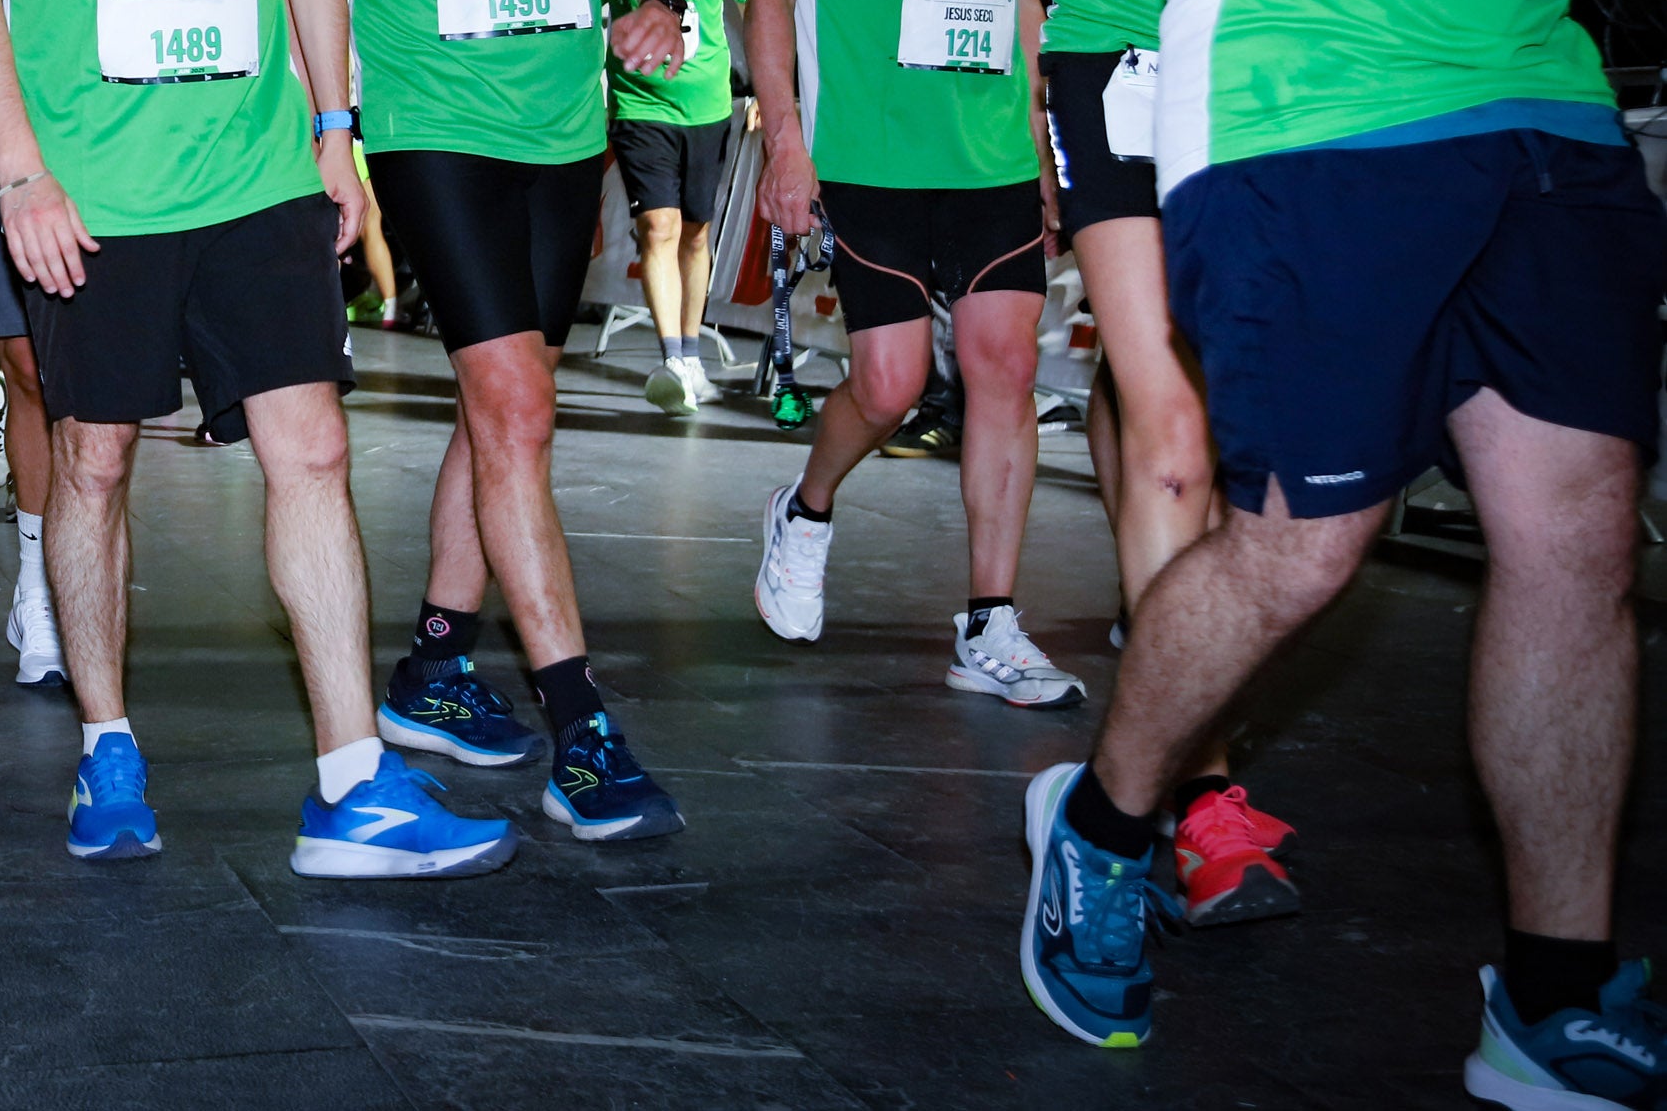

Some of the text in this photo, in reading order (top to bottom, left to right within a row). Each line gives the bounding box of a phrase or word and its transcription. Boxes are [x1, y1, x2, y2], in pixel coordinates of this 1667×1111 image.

[944, 6, 994, 23] JESUS SECO
[150, 25, 223, 65] 1489
[945, 27, 992, 59] 1214
